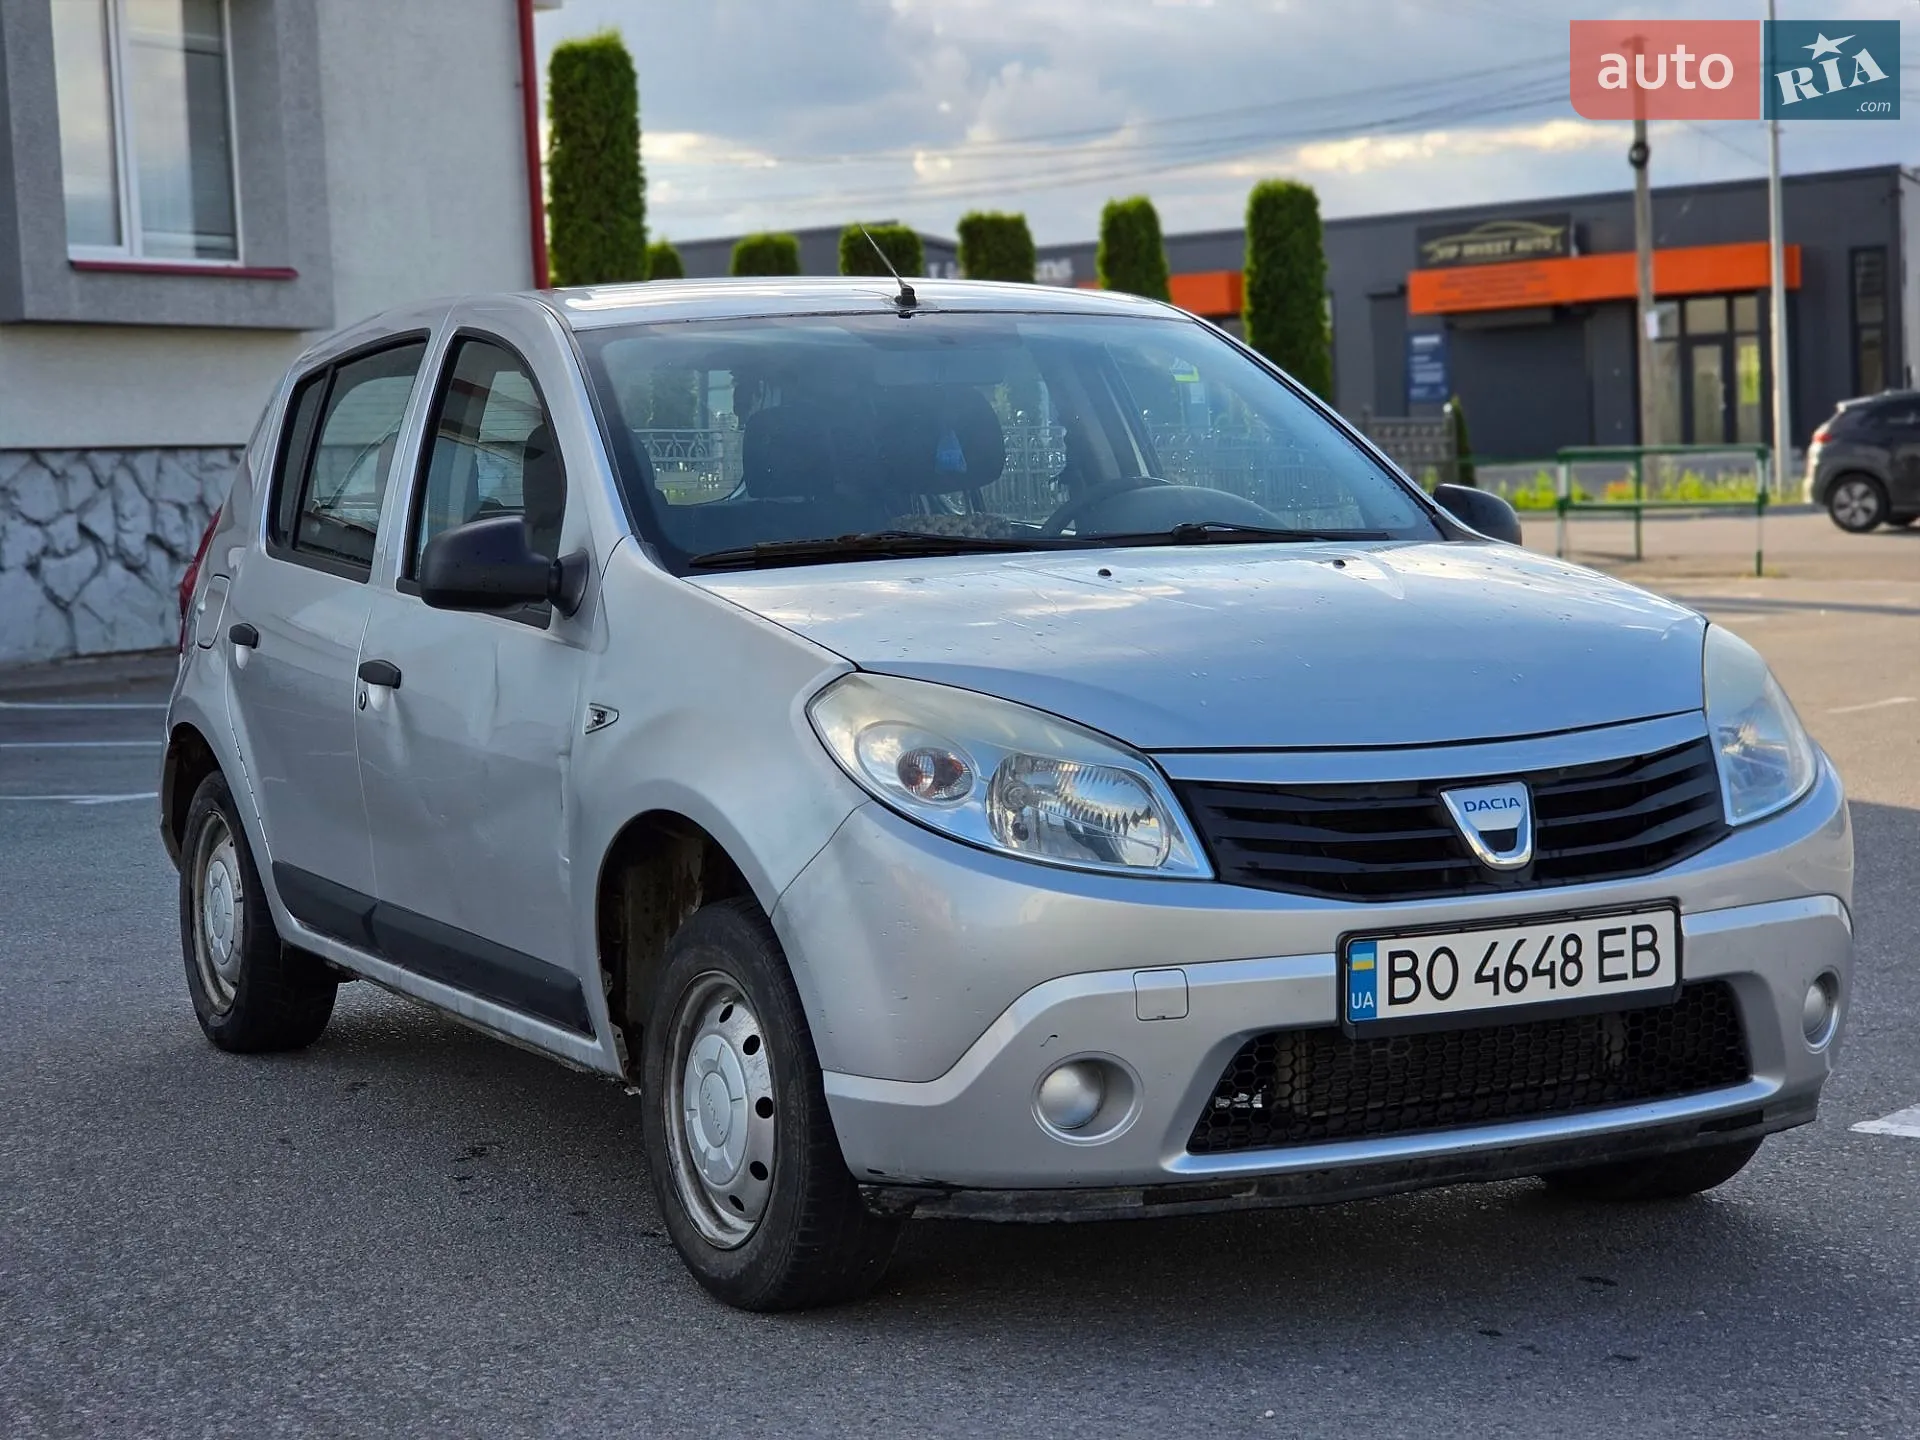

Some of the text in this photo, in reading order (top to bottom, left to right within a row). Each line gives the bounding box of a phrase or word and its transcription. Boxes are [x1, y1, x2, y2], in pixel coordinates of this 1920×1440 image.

[1464, 797, 1521, 812] DACIA
[1388, 924, 1661, 1006] BO 4648 EB
[1352, 991, 1375, 1010] UA
